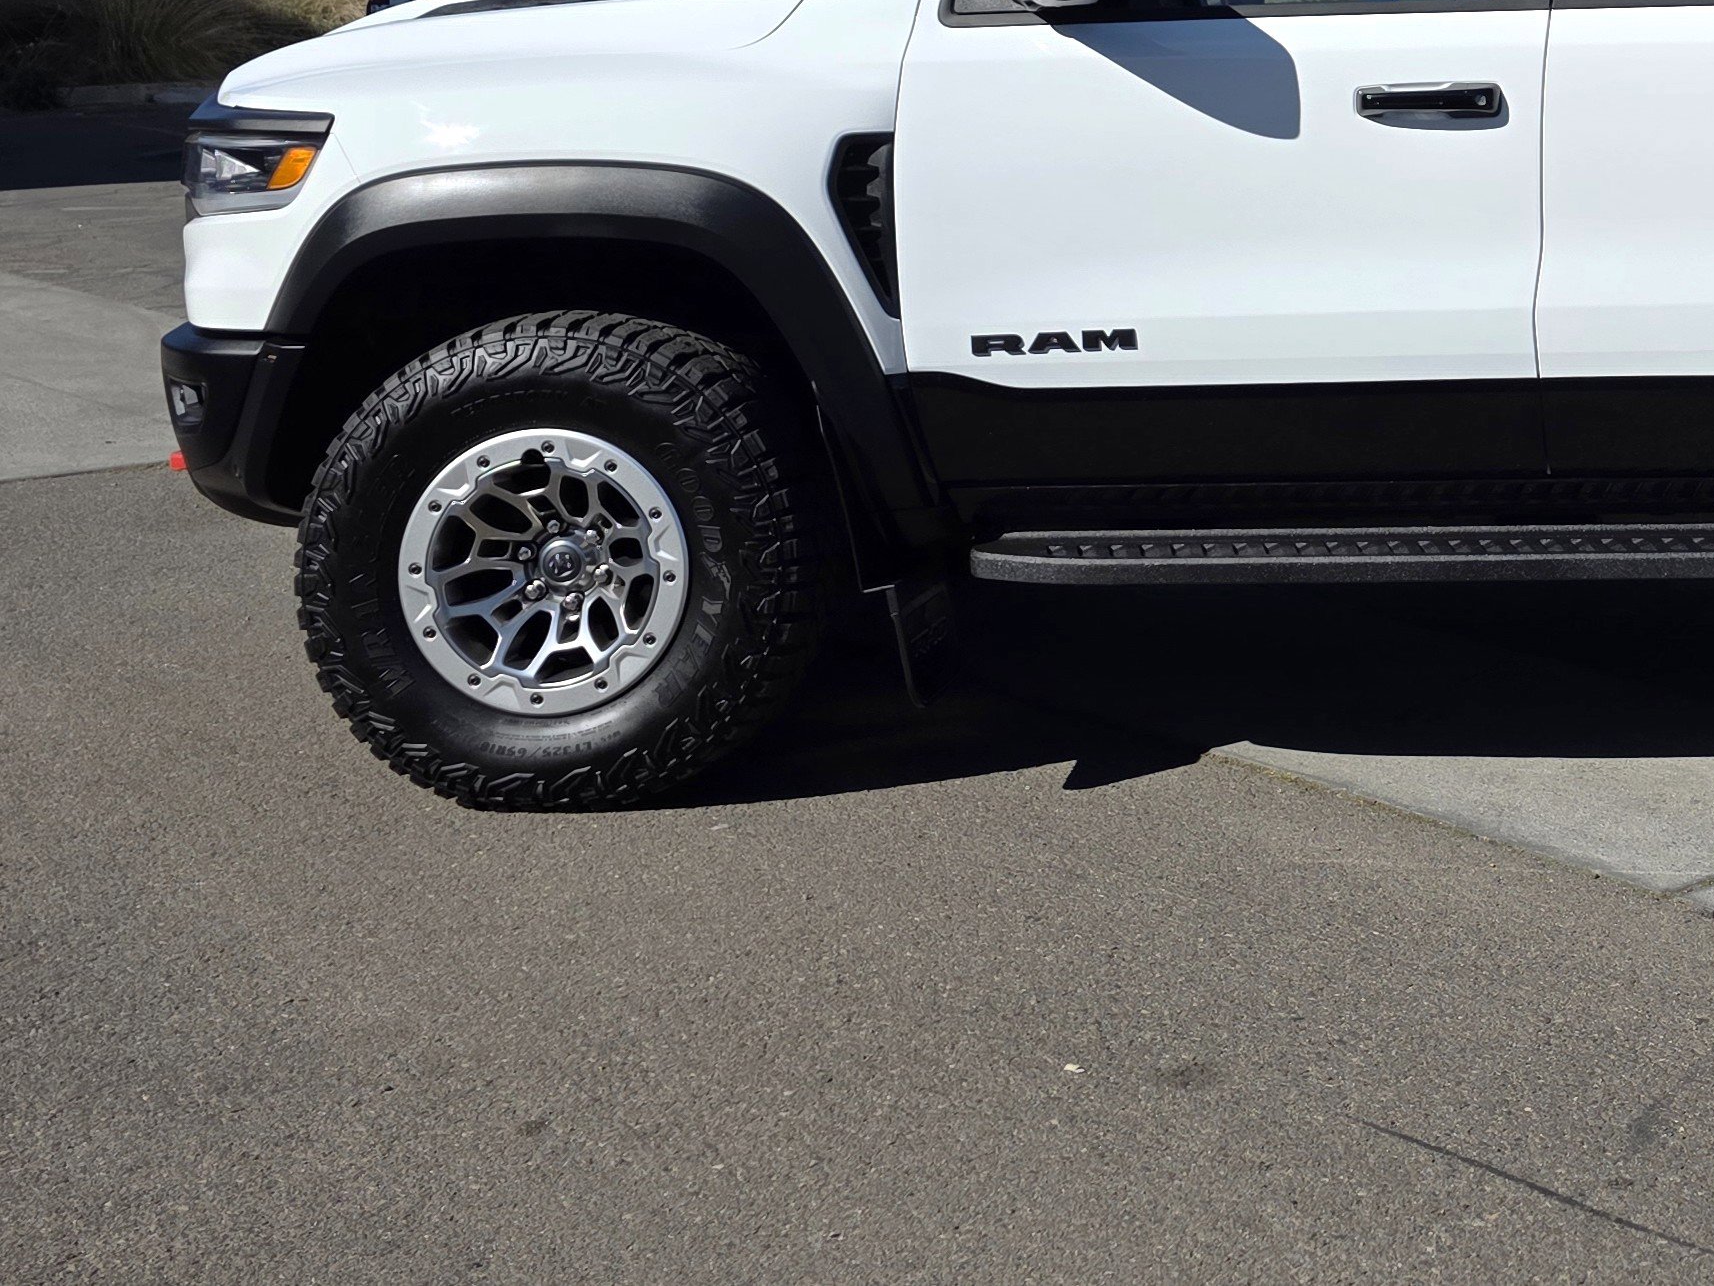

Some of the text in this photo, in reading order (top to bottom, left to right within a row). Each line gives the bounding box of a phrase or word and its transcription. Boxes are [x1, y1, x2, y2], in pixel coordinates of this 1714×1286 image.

[970, 328, 1139, 357] RAM
[655, 442, 727, 708] GOODYEAR
[479, 740, 593, 759] LT325/65R18
